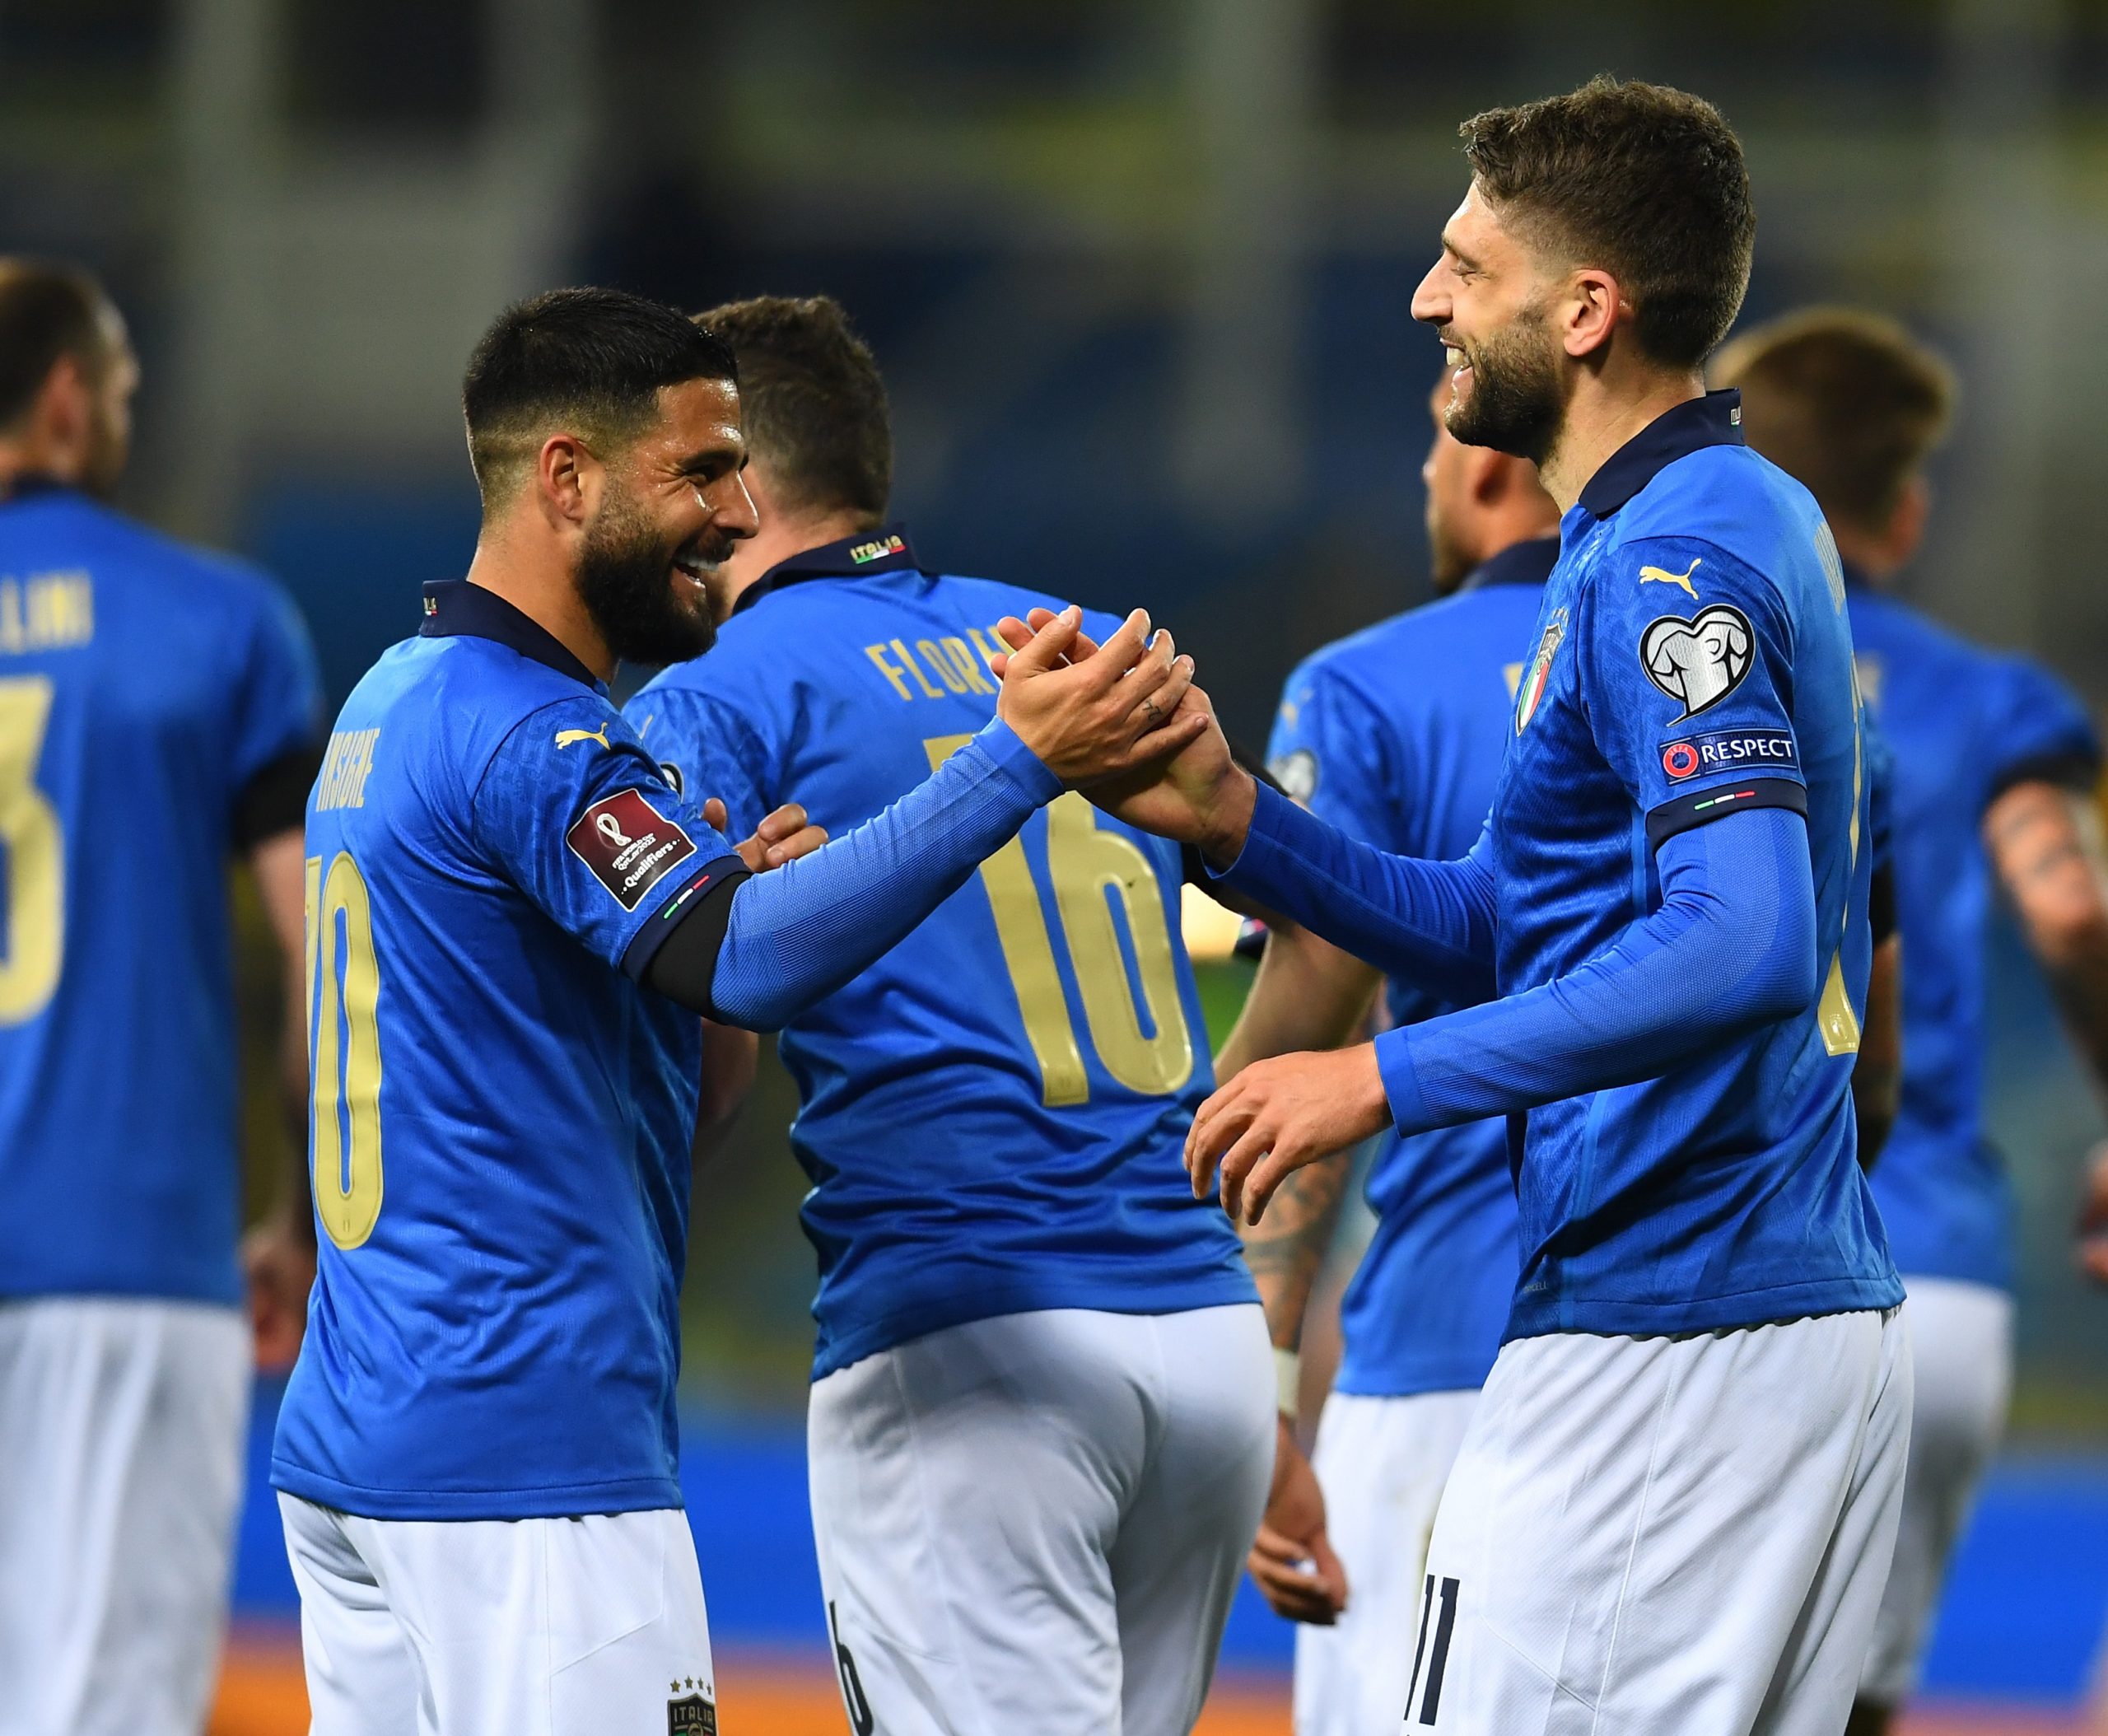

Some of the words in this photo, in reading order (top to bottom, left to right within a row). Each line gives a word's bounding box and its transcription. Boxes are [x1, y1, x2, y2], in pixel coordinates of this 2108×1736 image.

[1700, 739, 1793, 763] RESPECT
[624, 842, 674, 888] Qualifiers
[922, 733, 1193, 1107] 16
[1403, 1574, 1460, 1726] 11
[674, 1706, 714, 1724] ITALIA
